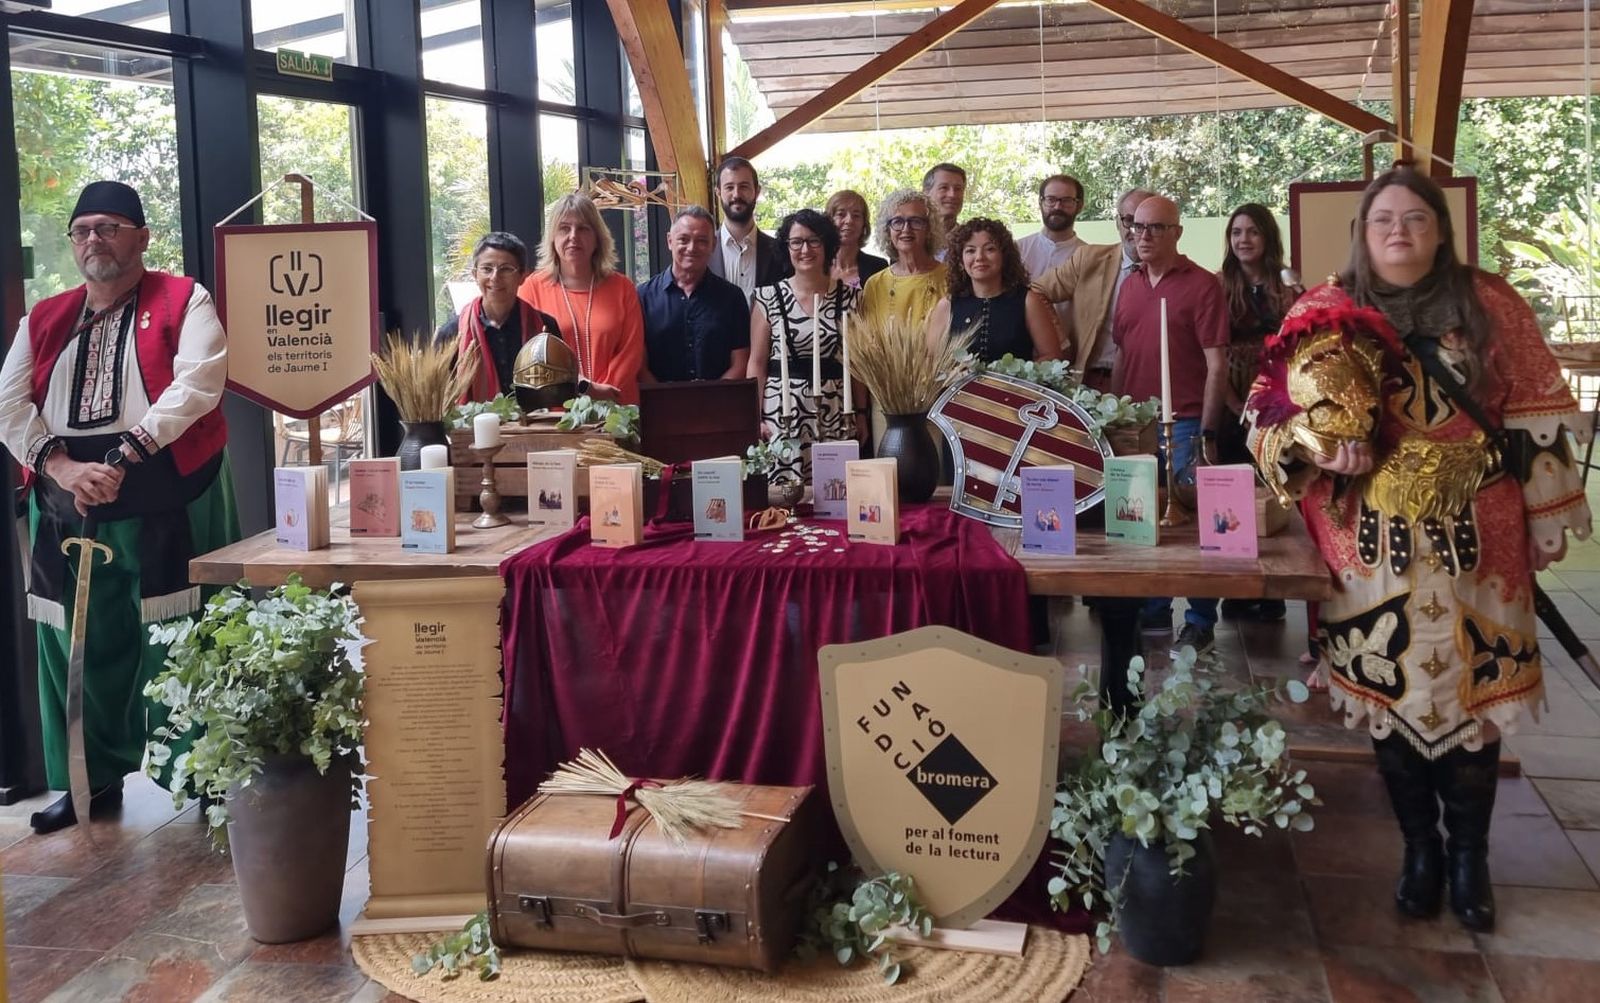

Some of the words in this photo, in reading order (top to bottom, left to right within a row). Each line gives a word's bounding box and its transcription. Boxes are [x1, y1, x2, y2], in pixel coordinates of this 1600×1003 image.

[280, 54, 320, 74] SALIDA
[266, 303, 332, 332] llegir
[267, 332, 333, 347] Valencià
[267, 351, 283, 361] els
[285, 350, 333, 361] territoris
[268, 362, 281, 374] de
[283, 362, 320, 374] Jaume
[322, 362, 328, 373] I
[414, 621, 447, 636] llegir
[916, 766, 991, 789] bromera
[905, 826, 928, 842] per
[932, 827, 945, 840] al
[948, 827, 1000, 845] foment
[905, 842, 923, 855] de
[929, 843, 942, 857] la
[948, 844, 1001, 862] lectura
